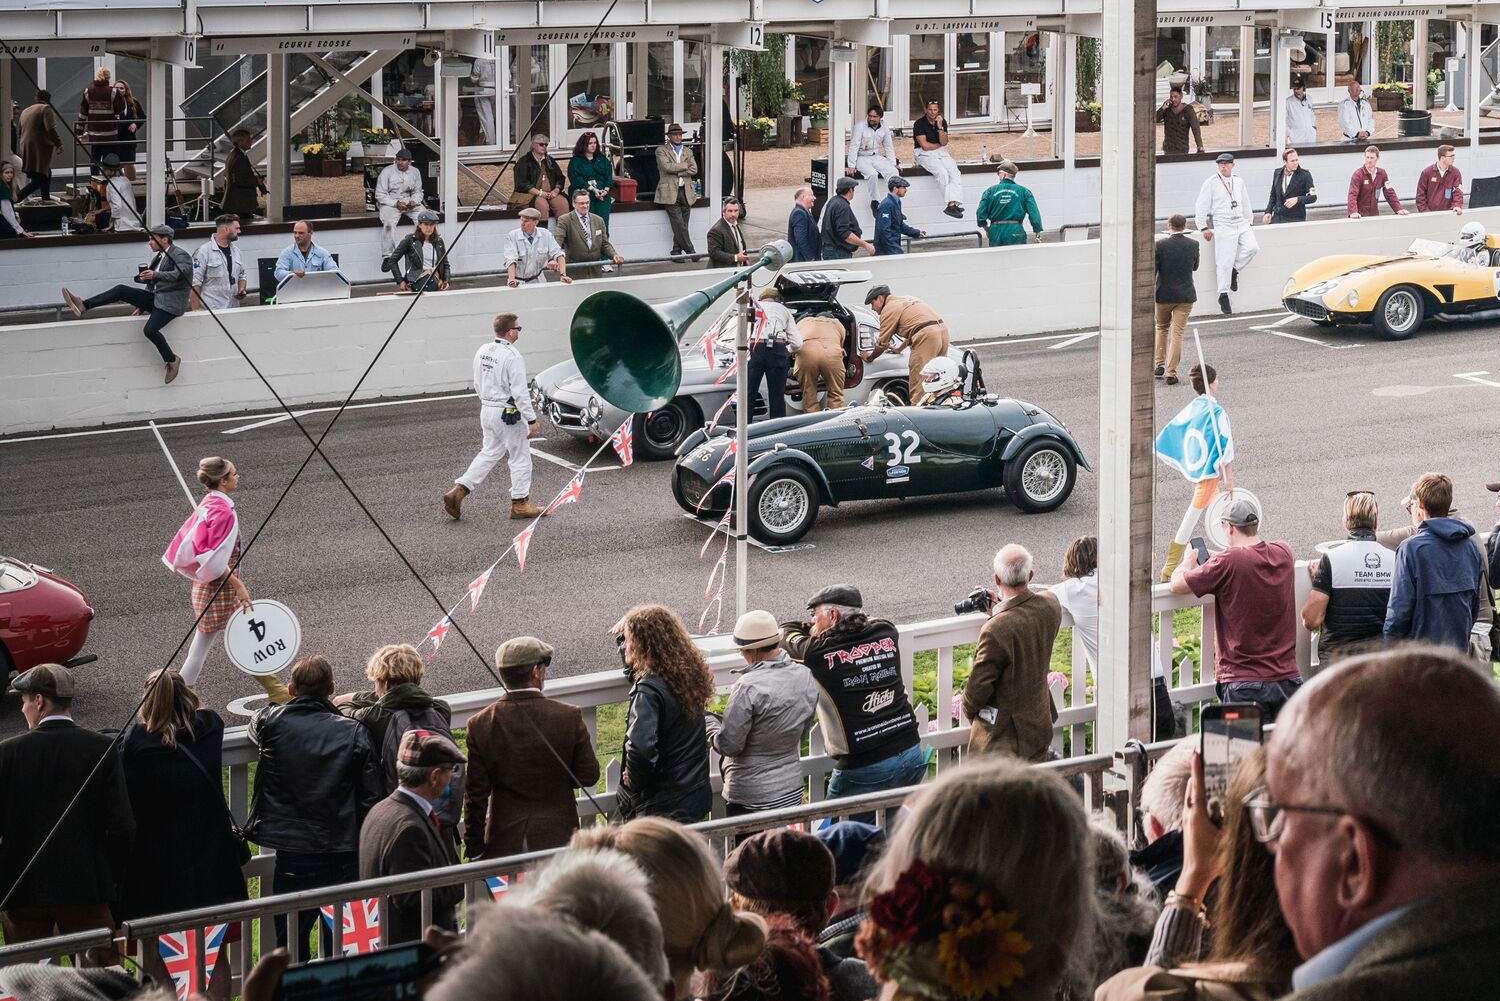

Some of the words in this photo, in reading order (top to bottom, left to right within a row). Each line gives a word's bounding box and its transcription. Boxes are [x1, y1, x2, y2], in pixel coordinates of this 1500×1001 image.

[1321, 12, 1332, 29] 15
[1384, 9, 1430, 17] ORGANISATION
[981, 21, 999, 29] TEAM
[278, 41, 314, 49] ECURIE
[317, 39, 352, 48] ECOSSE
[483, 34, 493, 53] 11
[537, 32, 579, 40] SCUDERIA
[750, 27, 761, 46] 12
[184, 41, 194, 62] 10
[884, 430, 921, 466] 32
[248, 618, 266, 642] 4
[253, 638, 286, 664] ROW
[824, 637, 896, 670] TROOPER
